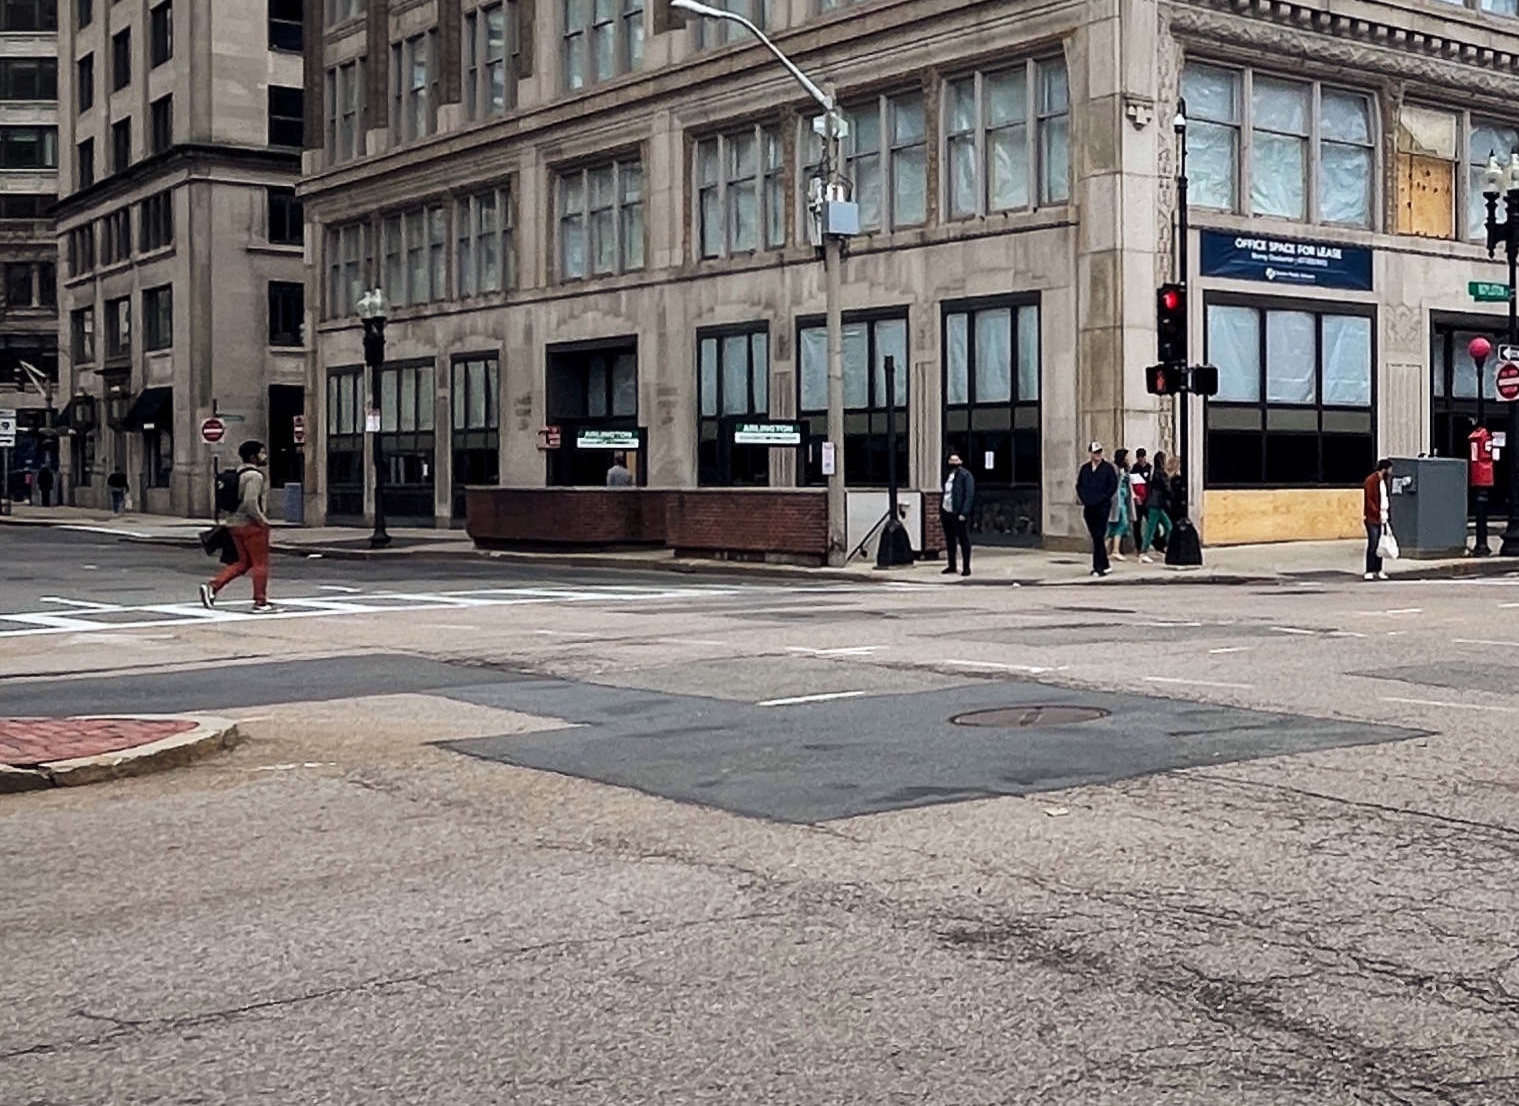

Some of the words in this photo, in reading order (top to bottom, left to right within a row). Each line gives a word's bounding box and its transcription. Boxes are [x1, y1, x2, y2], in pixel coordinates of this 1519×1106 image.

[1234, 237, 1267, 251] OFFICE
[1269, 241, 1296, 254] SPACE
[1297, 244, 1316, 255] FOR
[1317, 246, 1342, 259] LEASE
